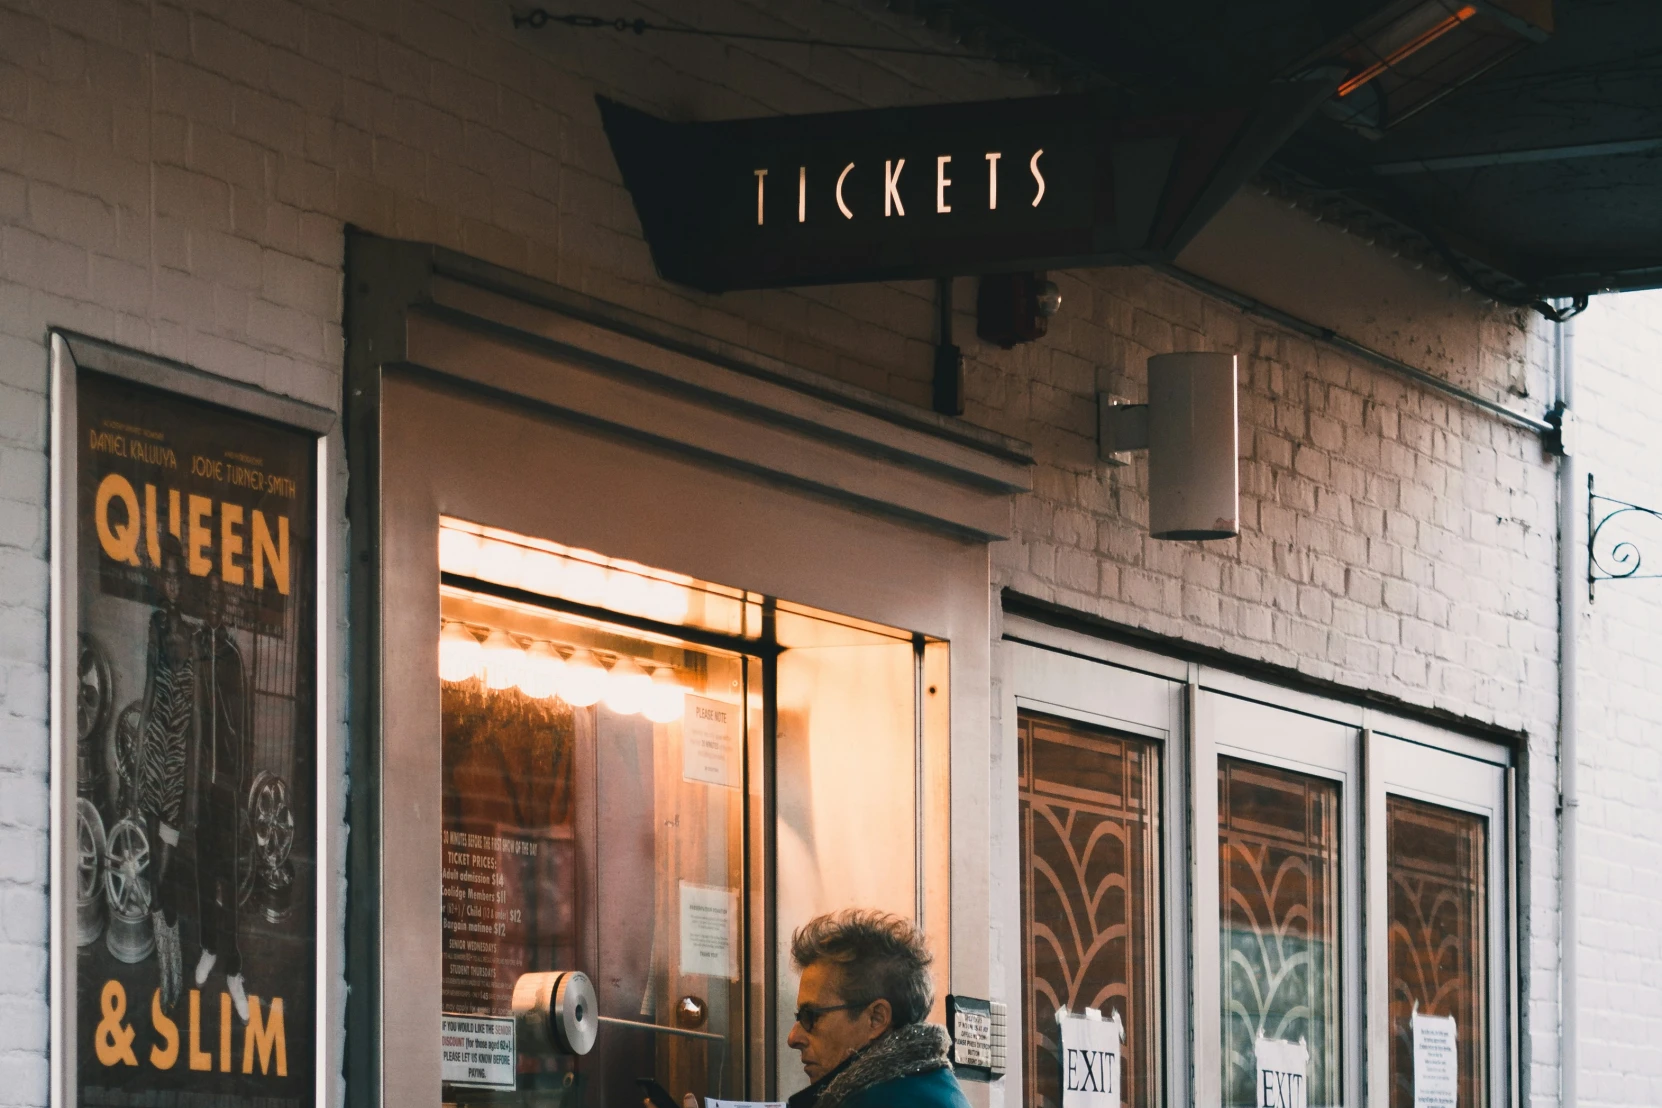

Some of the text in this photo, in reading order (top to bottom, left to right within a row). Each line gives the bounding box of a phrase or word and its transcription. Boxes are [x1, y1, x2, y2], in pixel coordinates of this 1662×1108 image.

[754, 149, 1045, 225] TICKETS
[90, 429, 127, 457] DANIEL
[130, 439, 177, 469] KALUUYA
[191, 455, 222, 481] JODIE
[227, 464, 296, 499] TURNER-SMITH
[95, 473, 290, 596] QUEEN
[696, 707, 727, 724] PLEASE NOTE
[449, 831, 467, 848] MINUTES
[467, 834, 483, 849] BEFORE
[483, 836, 491, 851] THE
[491, 837, 502, 852] FIRST
[502, 838, 514, 853] SHOW
[515, 840, 521, 854] OF
[521, 841, 529, 855] THE
[448, 851, 497, 869] TICKET PRICES:
[442, 867, 504, 887] Adult admission $14
[467, 888, 495, 903] Members
[496, 890, 507, 904] $11
[466, 905, 482, 918] Child
[509, 909, 521, 923] $12
[443, 918, 507, 937] Bargain matinee $12
[449, 939, 497, 954] SENIOR WEDNESDAYS
[450, 964, 497, 979] STUDENT THURSDAYS
[95, 979, 288, 1077] & SLIM
[442, 1021, 511, 1036] IF YOU WOULD LIKE THE SENIOR
[442, 1036, 465, 1047] DISCOUNT
[475, 1038, 487, 1049] those
[488, 1040, 499, 1052] aged
[443, 1051, 510, 1065] PLEASE LET US KNOW BEFORE
[468, 1067, 486, 1079] PAYING.
[1067, 1049, 1115, 1094] EXIT
[1262, 1069, 1303, 1108] EXIT
